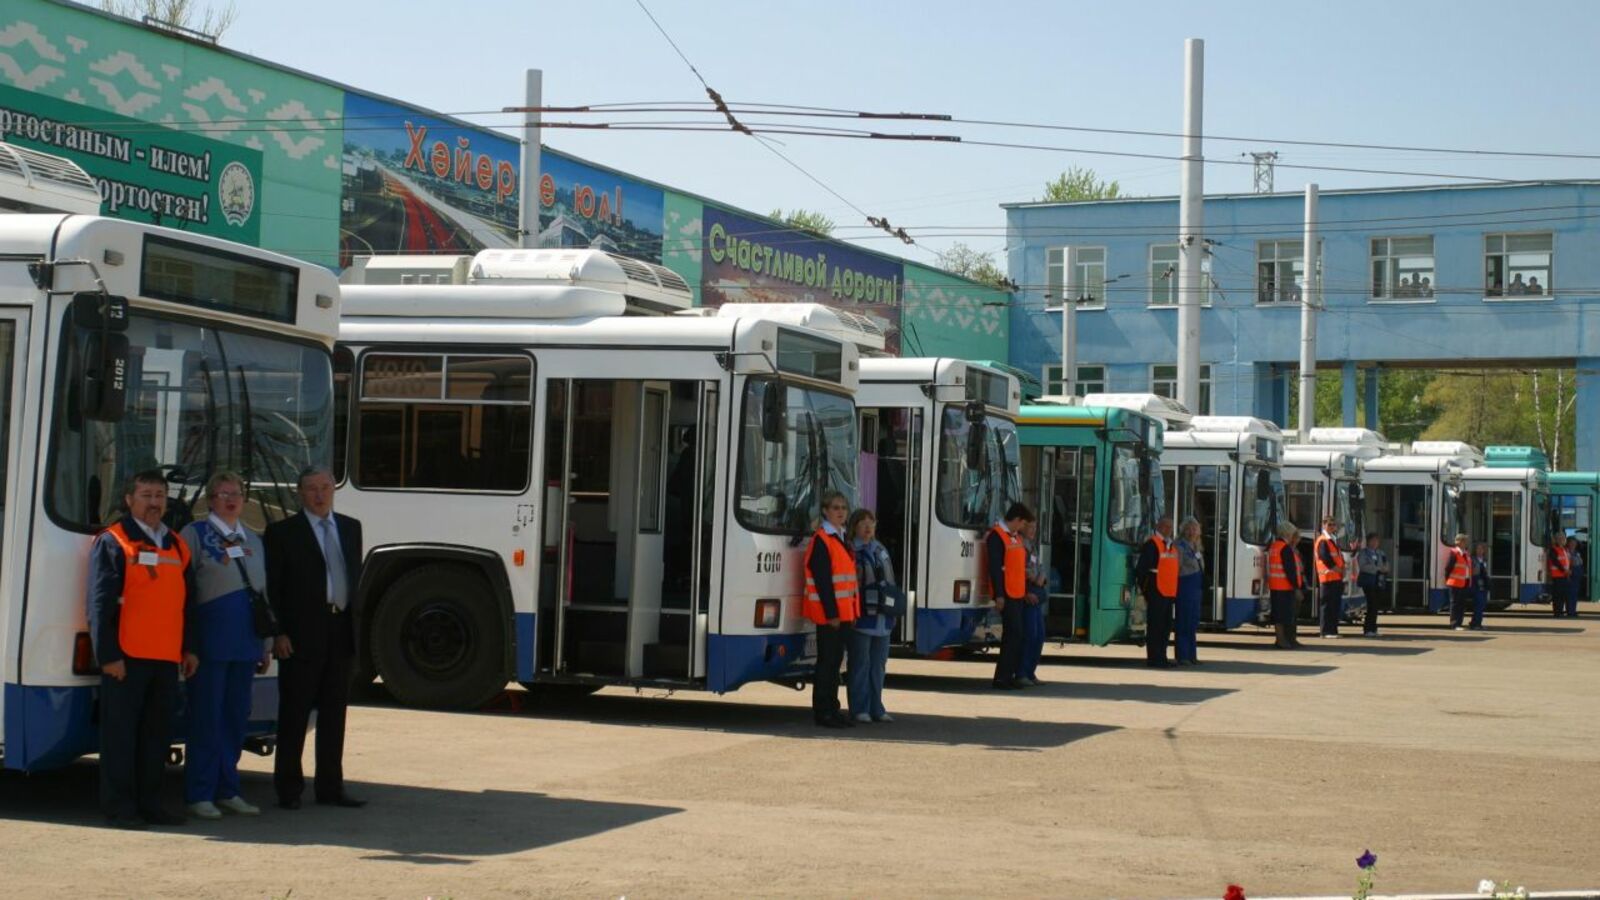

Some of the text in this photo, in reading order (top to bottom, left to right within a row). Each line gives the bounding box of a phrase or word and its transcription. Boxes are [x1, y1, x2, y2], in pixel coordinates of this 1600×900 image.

[150, 147, 211, 181] илем!
[403, 121, 622, 227] Хәйере юл!
[91, 177, 209, 222] ортостан!
[709, 223, 897, 307] Счастливой дороги!
[113, 358, 125, 390] 2012
[756, 552, 782, 573] 1010
